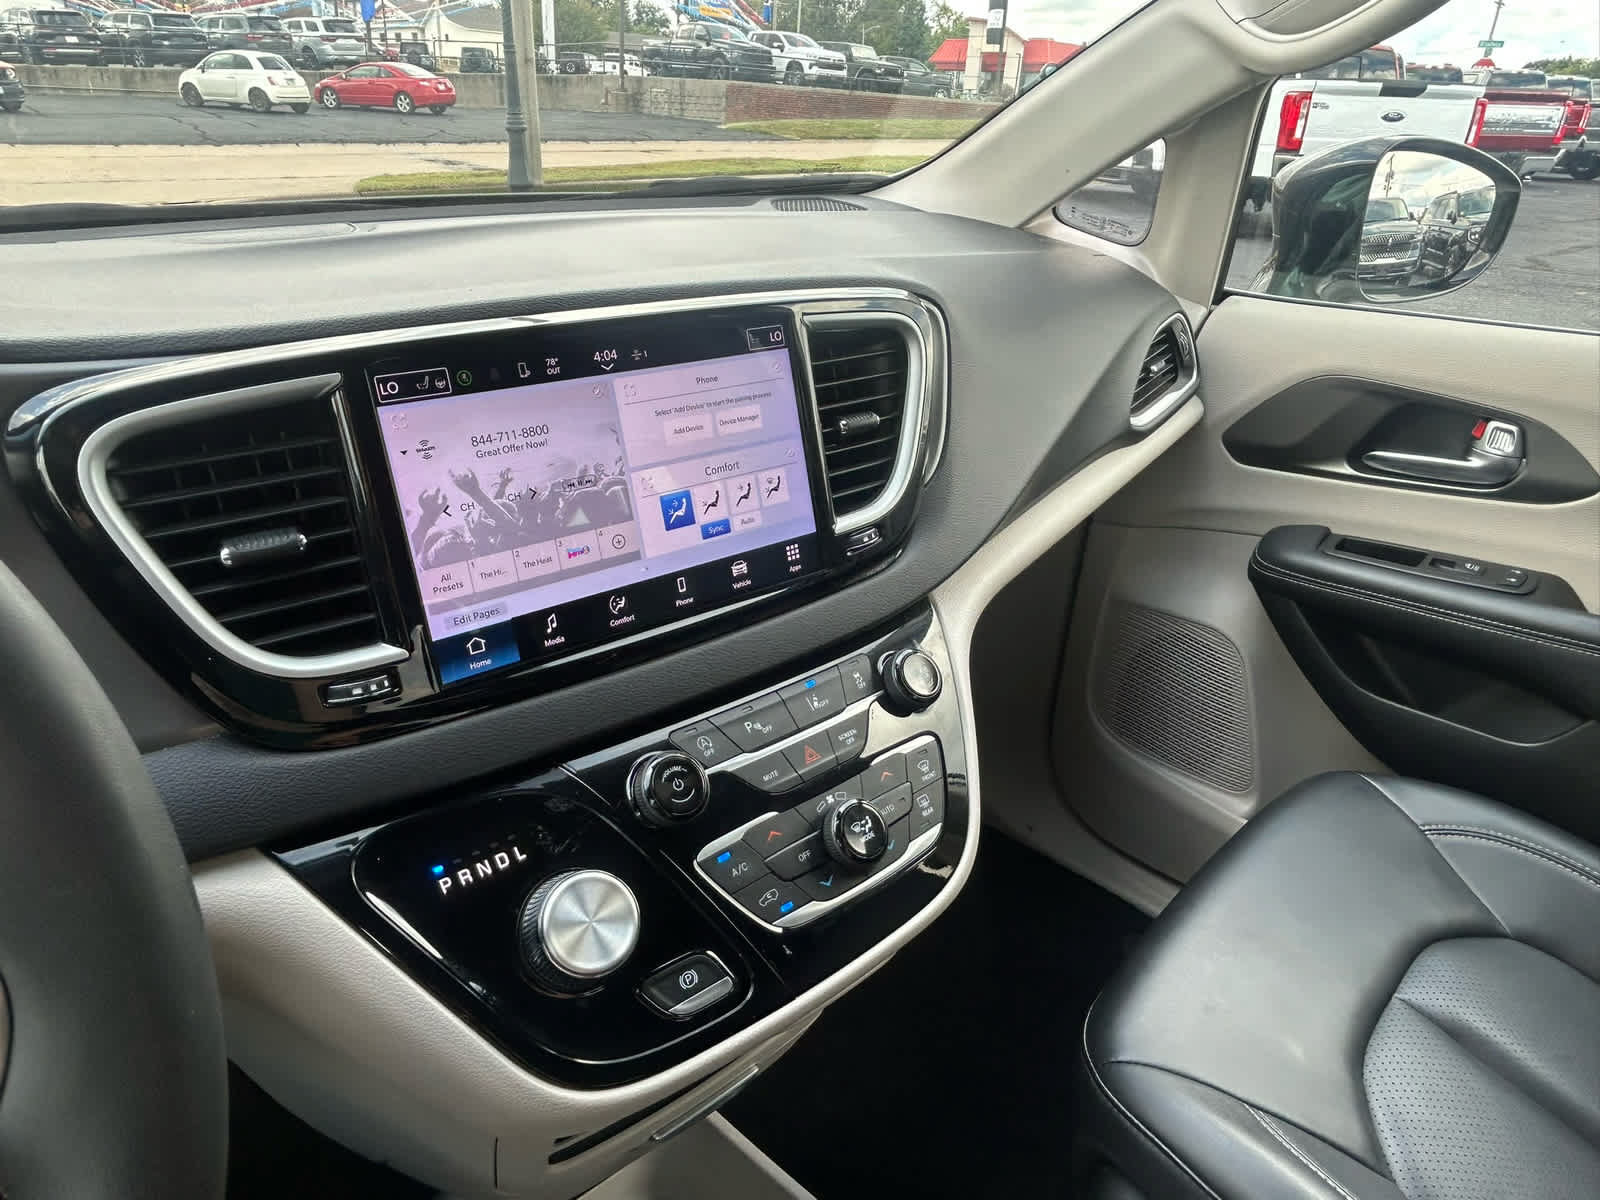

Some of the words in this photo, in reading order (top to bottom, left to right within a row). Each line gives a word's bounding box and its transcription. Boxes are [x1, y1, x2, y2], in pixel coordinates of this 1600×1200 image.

[770, 331, 782, 341] LO
[593, 349, 617, 361] 4:04
[546, 366, 561, 375] OUT
[696, 375, 719, 385] Phone
[379, 381, 399, 396] LO
[654, 408, 672, 417] Select
[720, 418, 736, 427] Device
[737, 414, 760, 425] Manager
[471, 424, 549, 447] 844-711-8800
[674, 427, 685, 435] Add
[686, 424, 704, 433] Device
[476, 447, 500, 459] Great
[502, 444, 524, 455] Offer
[526, 439, 548, 450] Now!
[705, 461, 740, 476] Comfort
[507, 492, 521, 502] CH
[460, 502, 476, 512] CH
[741, 516, 755, 526] Auto
[709, 525, 724, 536] Sync
[523, 560, 536, 569] The
[537, 556, 552, 566] Heat
[789, 564, 801, 573] Apps
[440, 573, 451, 583] All
[480, 571, 494, 580] The
[433, 581, 464, 595] Presets
[732, 579, 751, 589] Vehicle
[675, 597, 694, 607] Phone
[453, 614, 472, 626] Edit
[473, 608, 500, 622] Pages
[609, 614, 635, 627] Comfort
[544, 636, 565, 648] Media
[469, 658, 492, 670] Home
[744, 722, 752, 733] P
[838, 728, 856, 742] SCREEN
[763, 769, 779, 782] MUTE
[880, 804, 895, 816] AUTO
[798, 850, 811, 862] OFF
[731, 863, 749, 877] A/C
